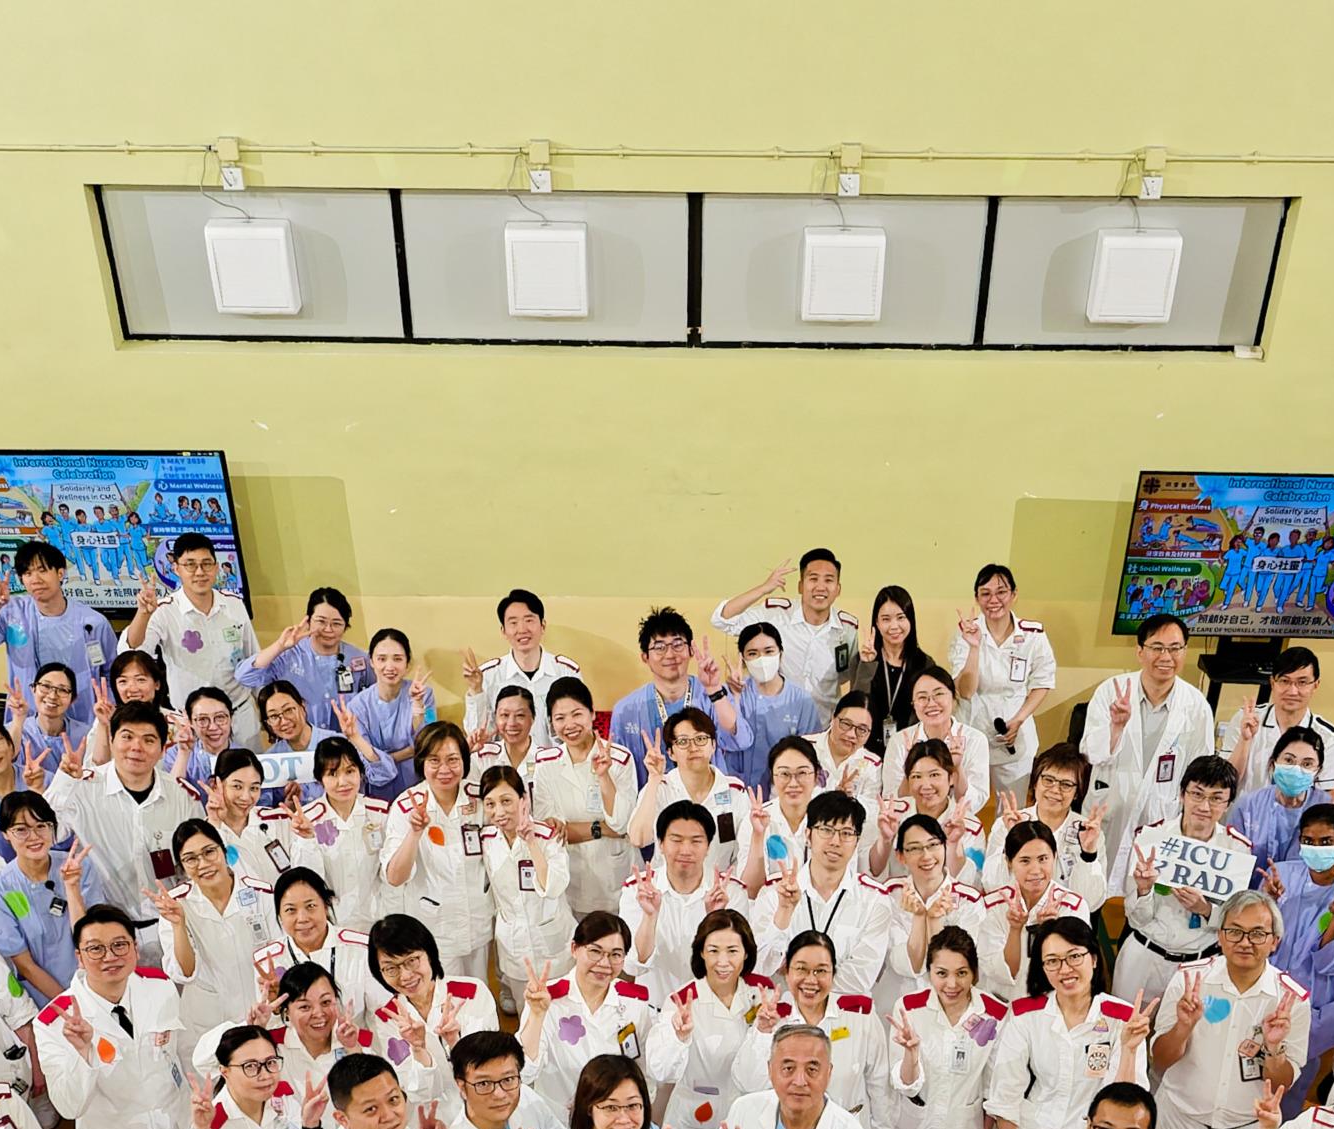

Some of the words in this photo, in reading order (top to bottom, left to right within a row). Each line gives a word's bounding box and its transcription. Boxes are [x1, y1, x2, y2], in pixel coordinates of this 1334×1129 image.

[13, 456, 85, 467] International
[87, 457, 125, 467] Nurses
[127, 457, 149, 470] Day
[52, 469, 116, 480] Celebration
[1228, 478, 1303, 489] International
[1263, 491, 1331, 502] Celebration
[1265, 507, 1303, 516] Solidarity
[1159, 836, 1232, 871] #ICU
[1169, 863, 1234, 896] RAD
